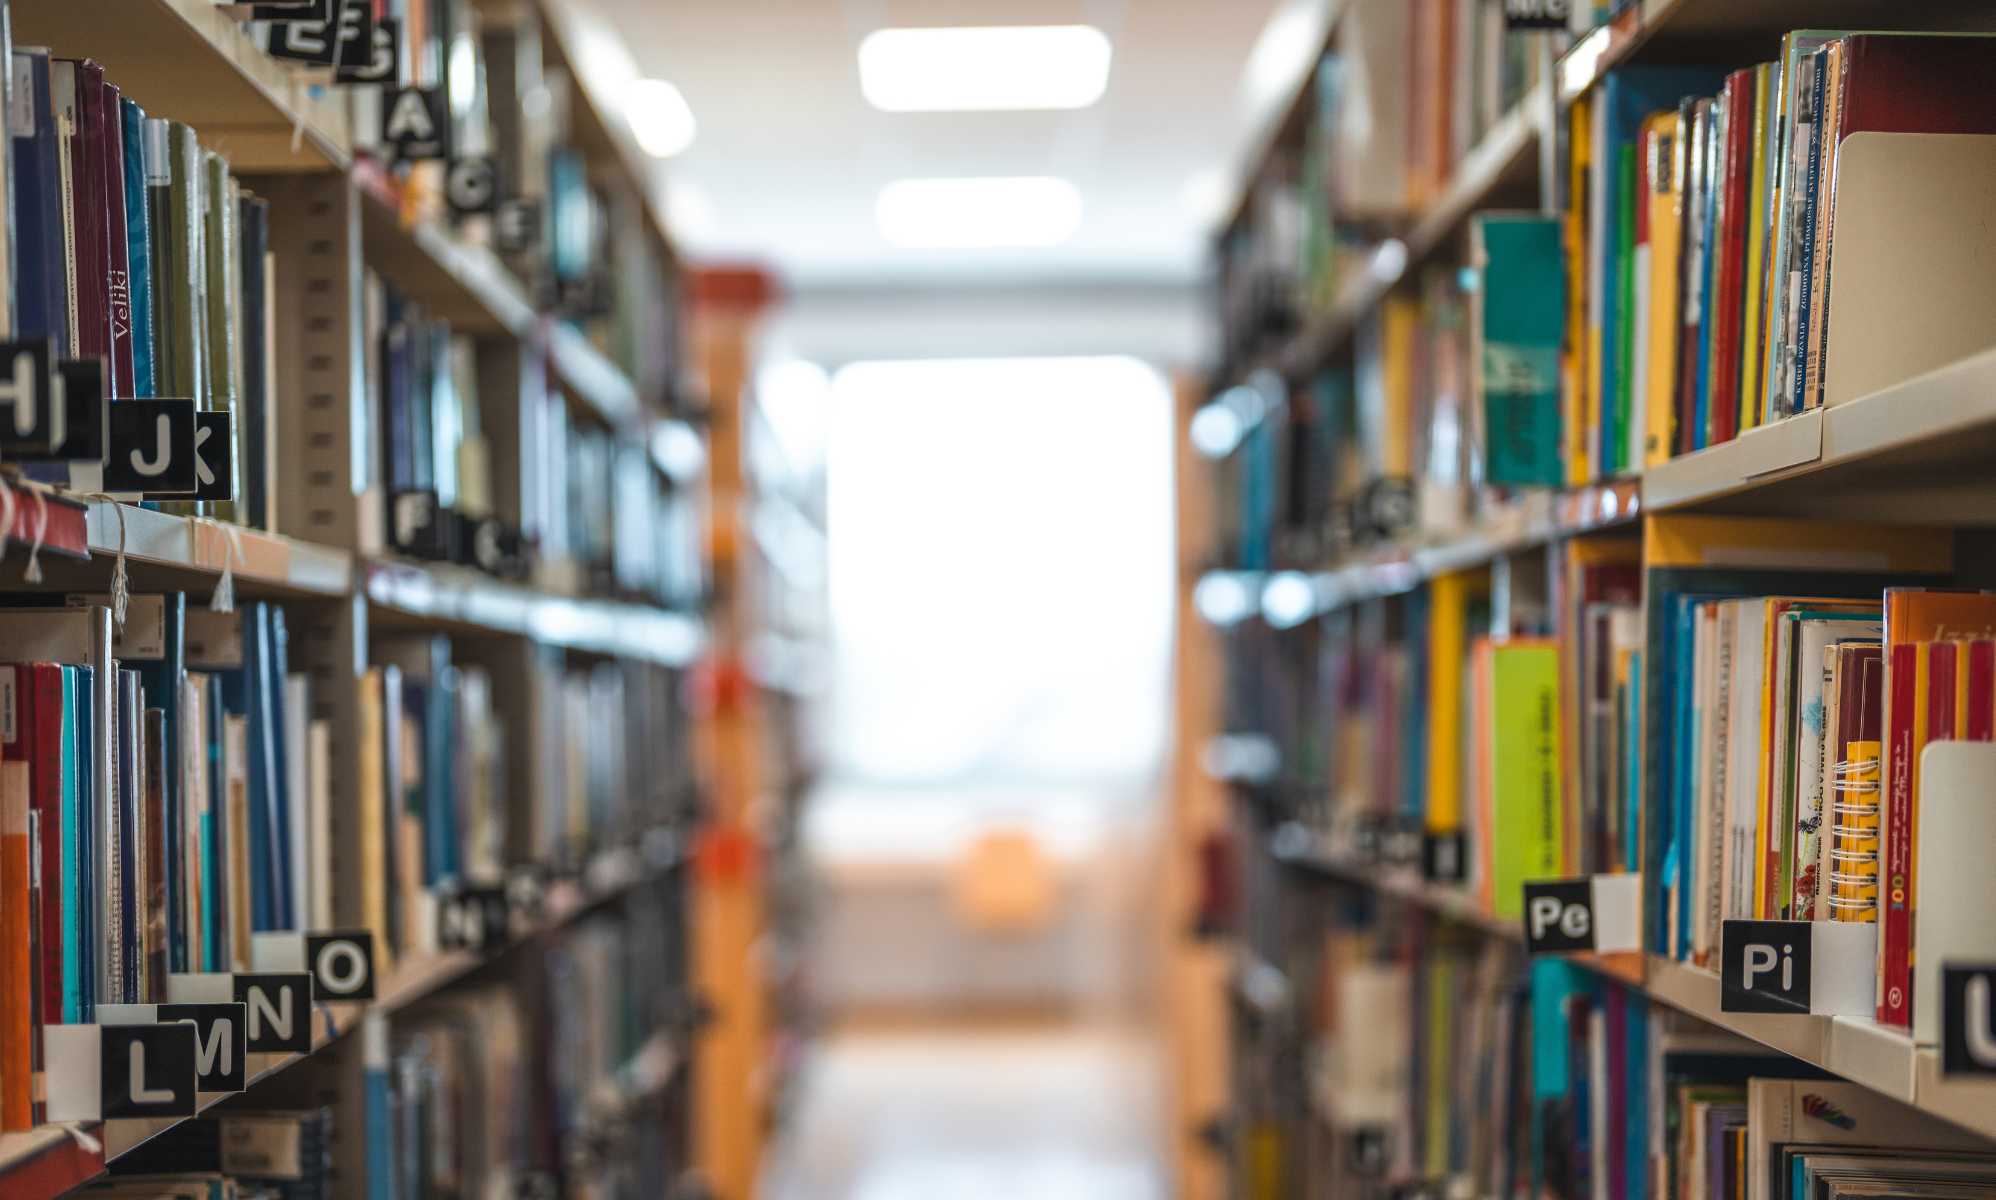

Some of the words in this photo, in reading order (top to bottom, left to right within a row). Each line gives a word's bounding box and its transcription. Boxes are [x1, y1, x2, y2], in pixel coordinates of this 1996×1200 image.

[388, 90, 435, 141] A
[112, 270, 128, 340] Veliki
[129, 413, 171, 476] J
[1529, 895, 1590, 940] Pe
[1890, 875, 1905, 910] 100
[315, 939, 369, 995] O
[1743, 943, 1793, 991] Pi
[247, 984, 293, 1041] N
[129, 1040, 175, 1103] L
